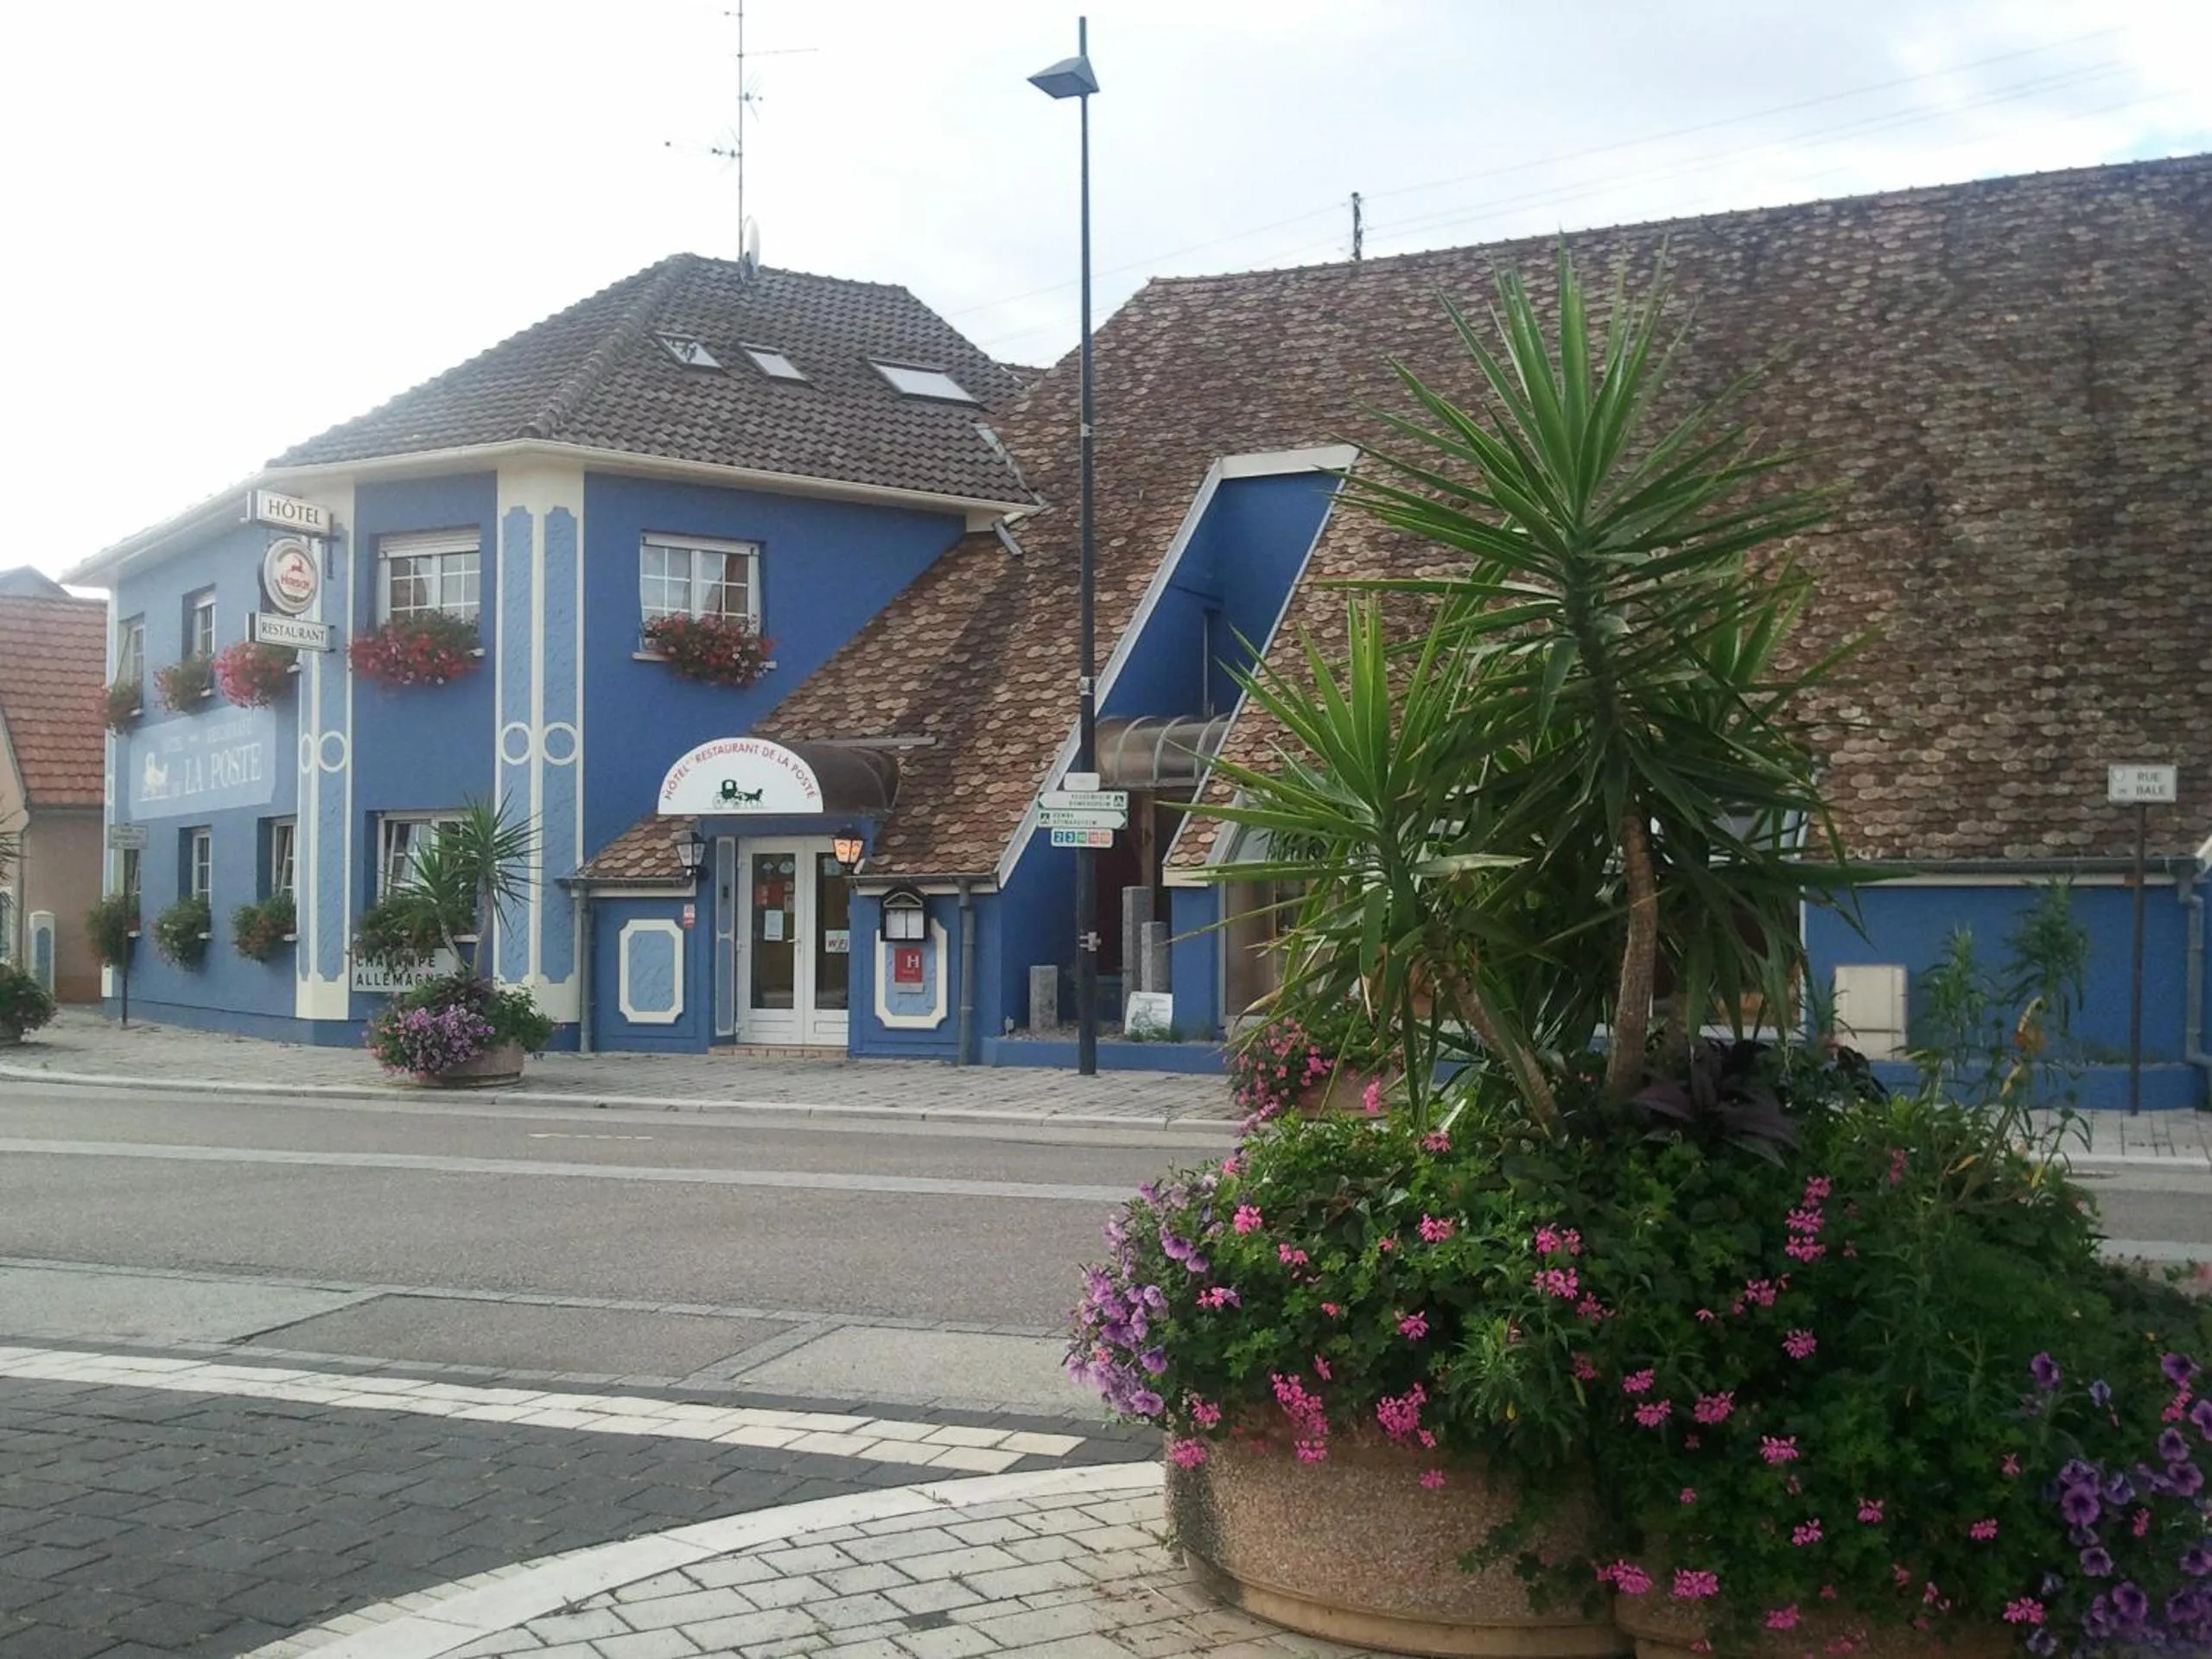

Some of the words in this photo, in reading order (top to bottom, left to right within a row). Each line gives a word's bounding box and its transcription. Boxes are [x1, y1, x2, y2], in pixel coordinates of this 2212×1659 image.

[262, 621, 324, 642] RESTAURANT
[210, 743, 262, 790] POSTE
[695, 744, 759, 765] RESTAURANT
[761, 747, 775, 759] DE
[777, 755, 789, 767] LA
[791, 764, 816, 799] POSTE
[907, 955, 920, 969] H
